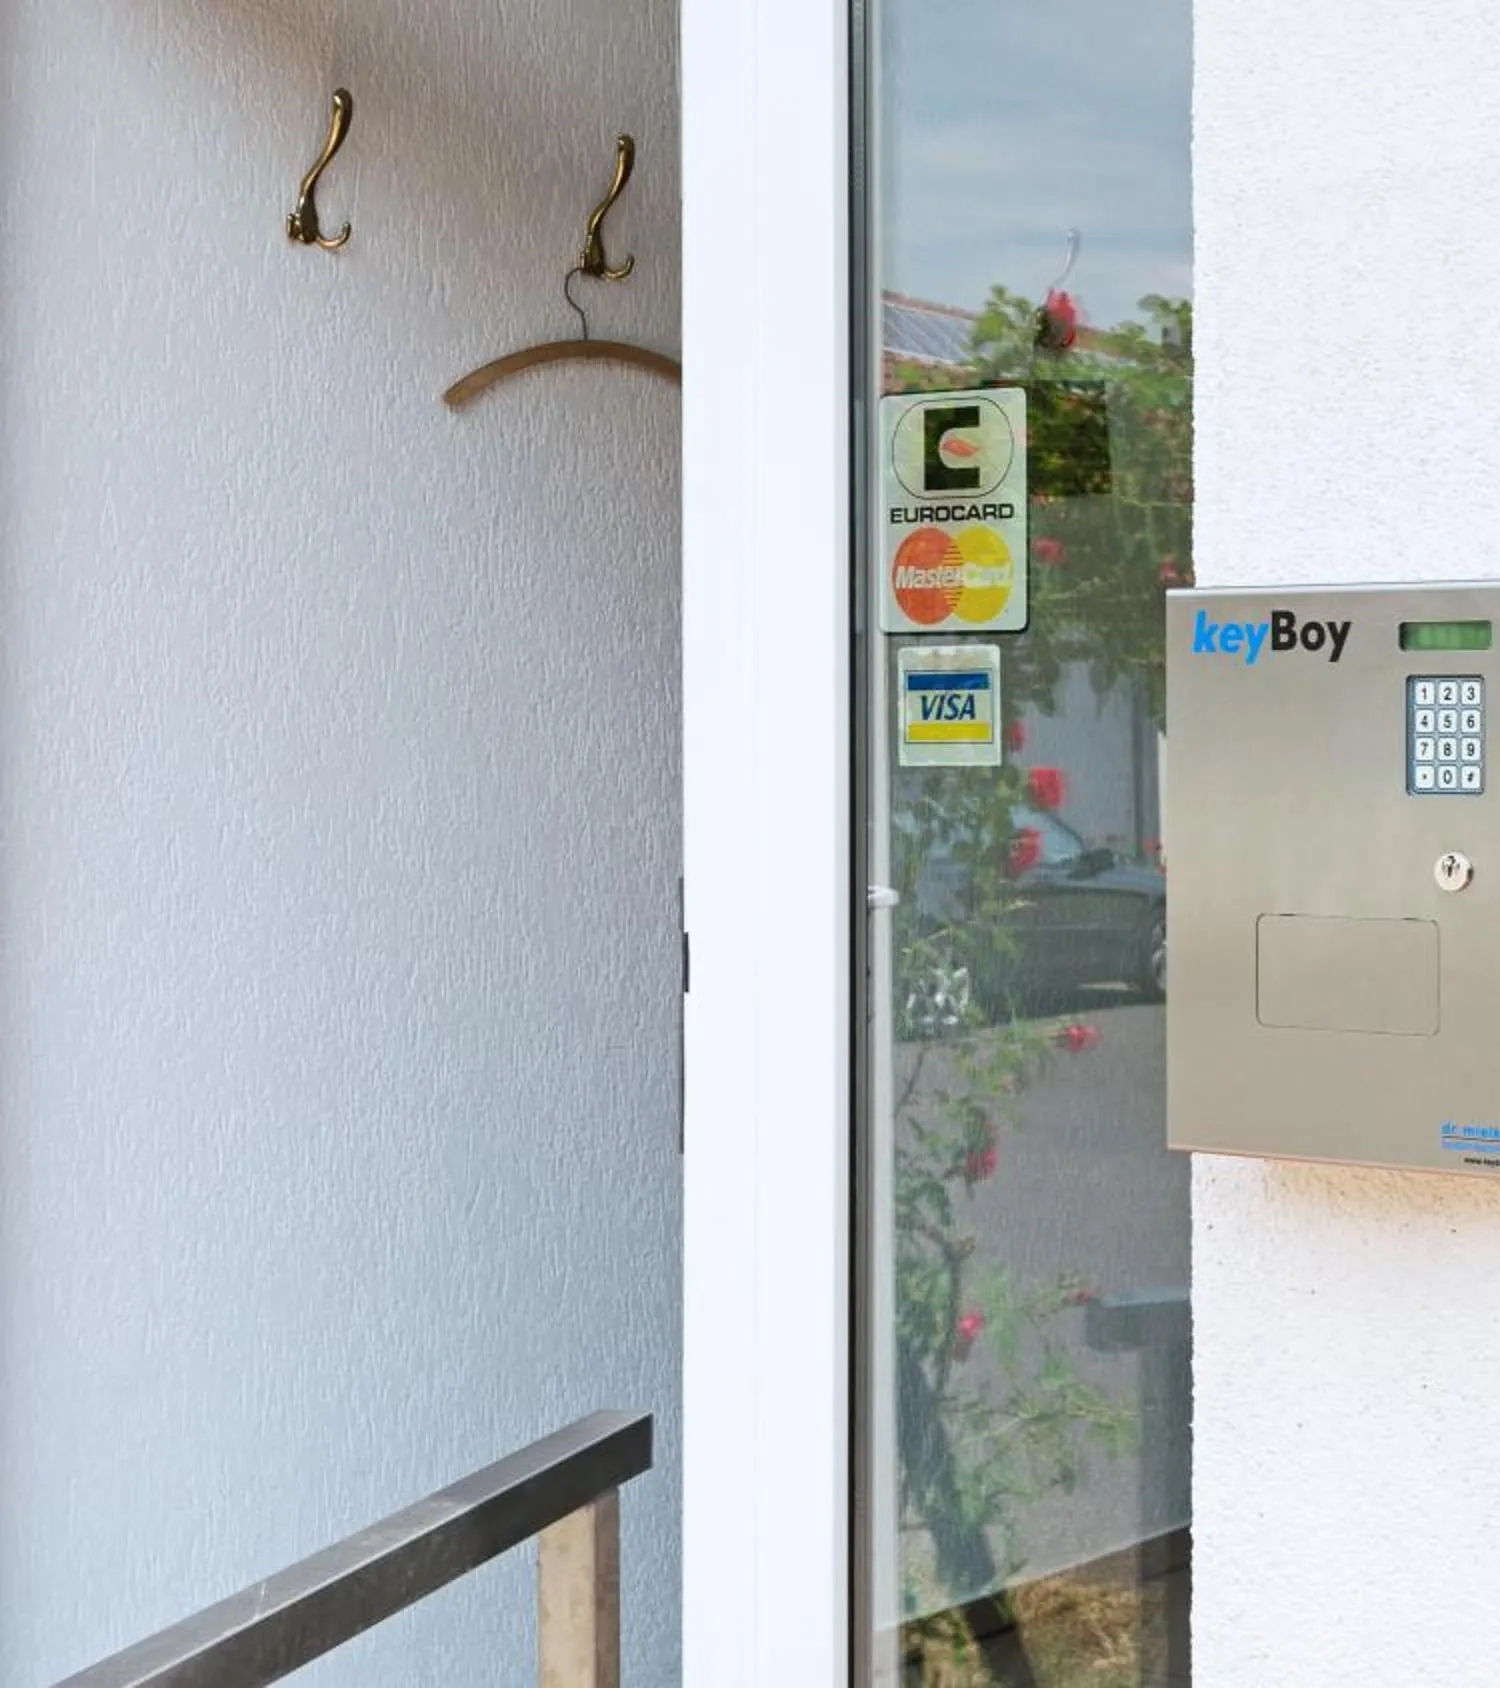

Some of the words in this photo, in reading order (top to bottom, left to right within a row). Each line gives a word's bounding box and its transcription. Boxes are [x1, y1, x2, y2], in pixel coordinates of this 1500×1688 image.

[890, 503, 1015, 524] EUROCARD
[894, 562, 1014, 590] MasterCard
[1192, 609, 1352, 665] keyBoy
[1421, 686, 1427, 701] 1
[1443, 686, 1452, 701] 2
[1467, 686, 1475, 701] 3
[920, 694, 976, 720] VISA
[1420, 714, 1429, 728] 4
[1443, 714, 1452, 729] 5
[1467, 714, 1475, 729] 6
[1420, 742, 1429, 756] 7
[1443, 742, 1452, 757] 8
[1467, 742, 1475, 757] 9
[1443, 769, 1452, 784] 0
